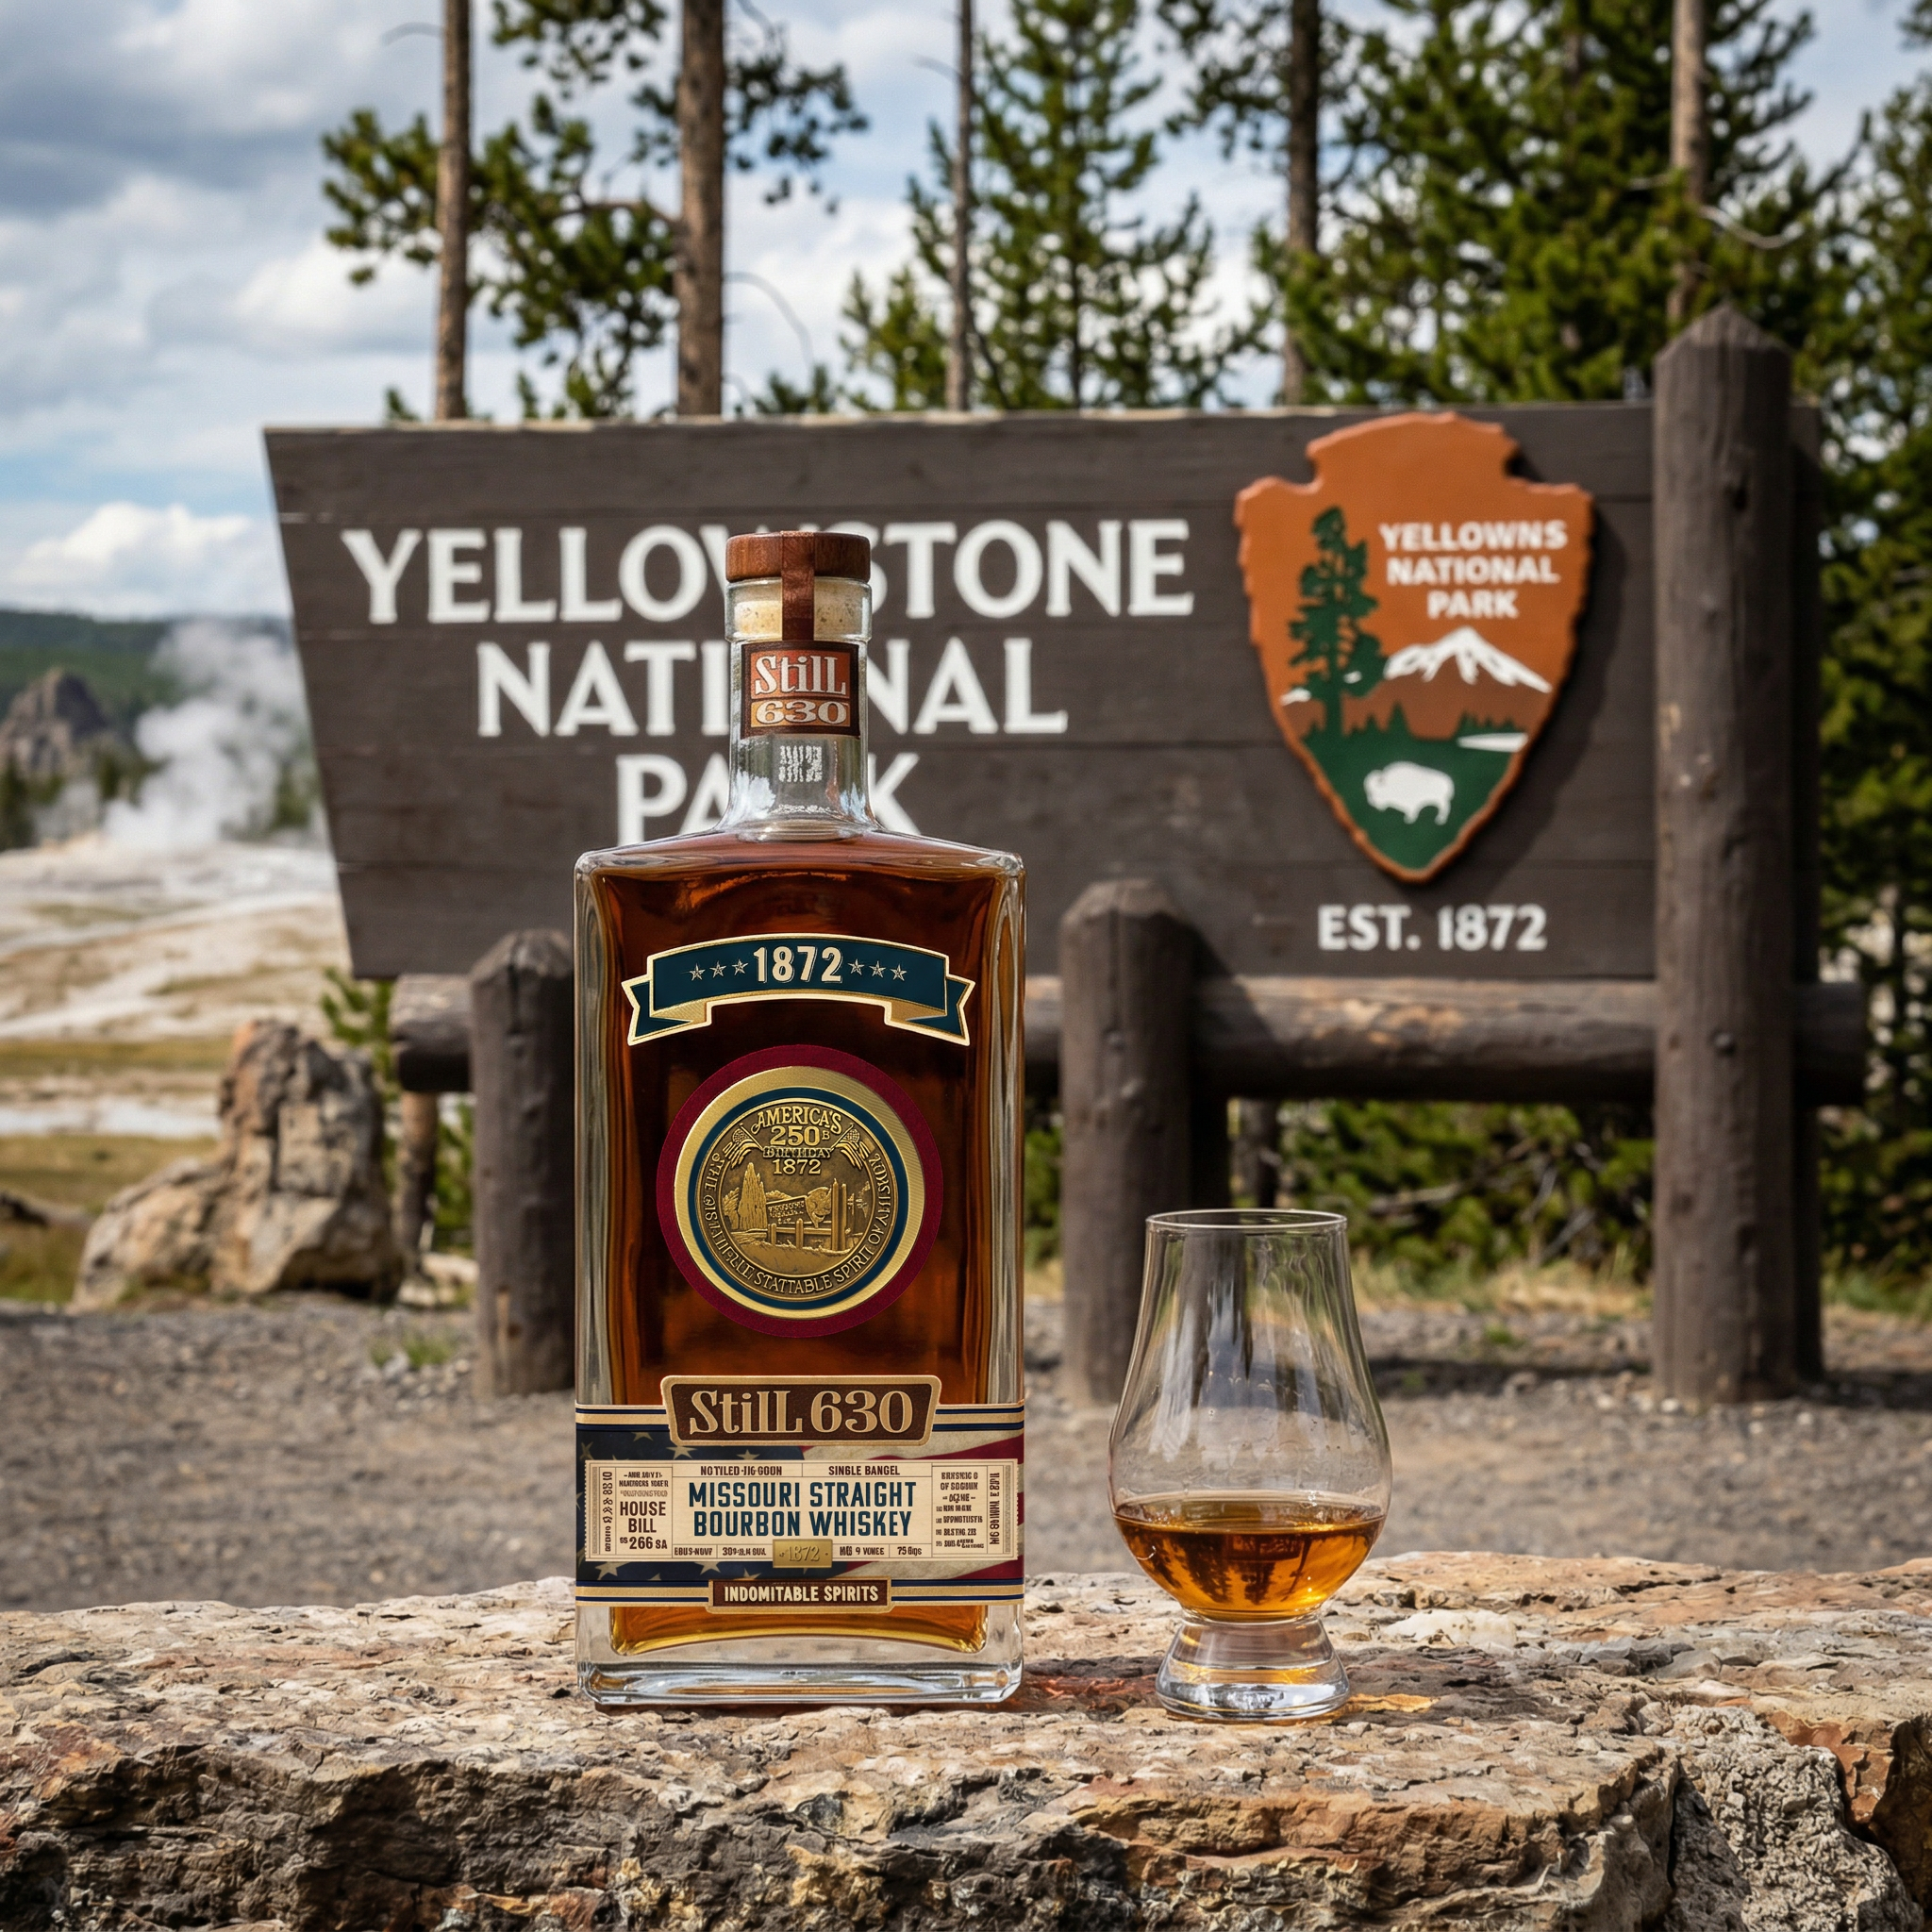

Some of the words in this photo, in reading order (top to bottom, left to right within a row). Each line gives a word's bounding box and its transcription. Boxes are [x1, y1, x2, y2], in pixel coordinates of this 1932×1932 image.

[1379, 520, 1568, 552] YELLOWNS
[341, 520, 1195, 624] YELLOTONE
[1387, 555, 1559, 586] NATIONAL
[1427, 590, 1519, 619] PARK
[476, 638, 1068, 737] NATINAL
[756, 700, 847, 724] 630
[616, 751, 922, 847] PAK
[1318, 904, 1421, 951] EST.
[1437, 903, 1547, 951] 1872
[754, 945, 842, 983] 1872
[751, 1106, 842, 1135] AMERICA'S
[773, 1159, 822, 1174] 1872
[810, 1390, 913, 1433] 630
[620, 1501, 666, 1516] HOUSE
[689, 1482, 800, 1507] MISSOURI
[809, 1482, 916, 1507] STRAIGHT
[628, 1518, 657, 1533] BILL
[693, 1511, 800, 1536] BOURBON
[809, 1511, 911, 1536] WHISKEY
[629, 1536, 653, 1549] 266
[655, 1539, 667, 1549] SA
[724, 1586, 820, 1602] INDOMITABLE
[824, 1585, 878, 1602] SPIRITS
